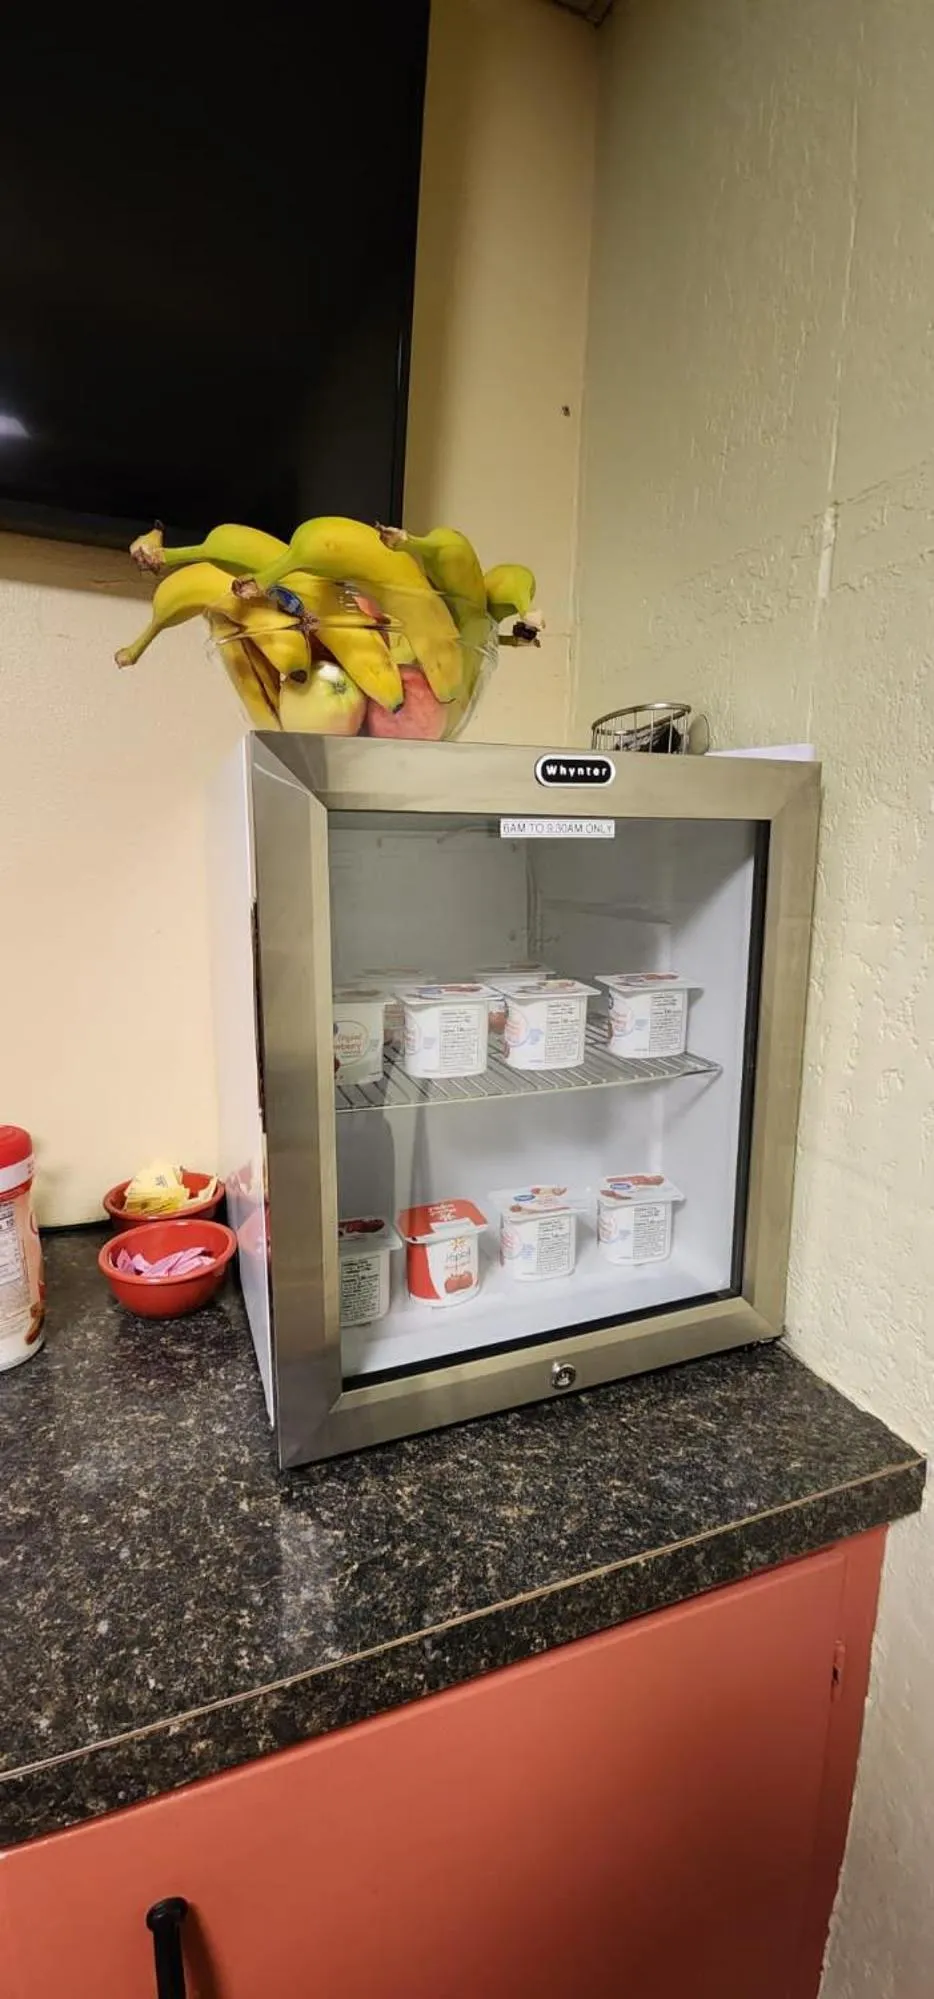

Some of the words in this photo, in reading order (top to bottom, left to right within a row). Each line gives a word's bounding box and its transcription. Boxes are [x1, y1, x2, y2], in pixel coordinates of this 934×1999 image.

[545, 764, 607, 777] Whynter
[503, 823, 526, 833] 6AM
[530, 823, 545, 833] TO
[585, 823, 612, 834] ONLY
